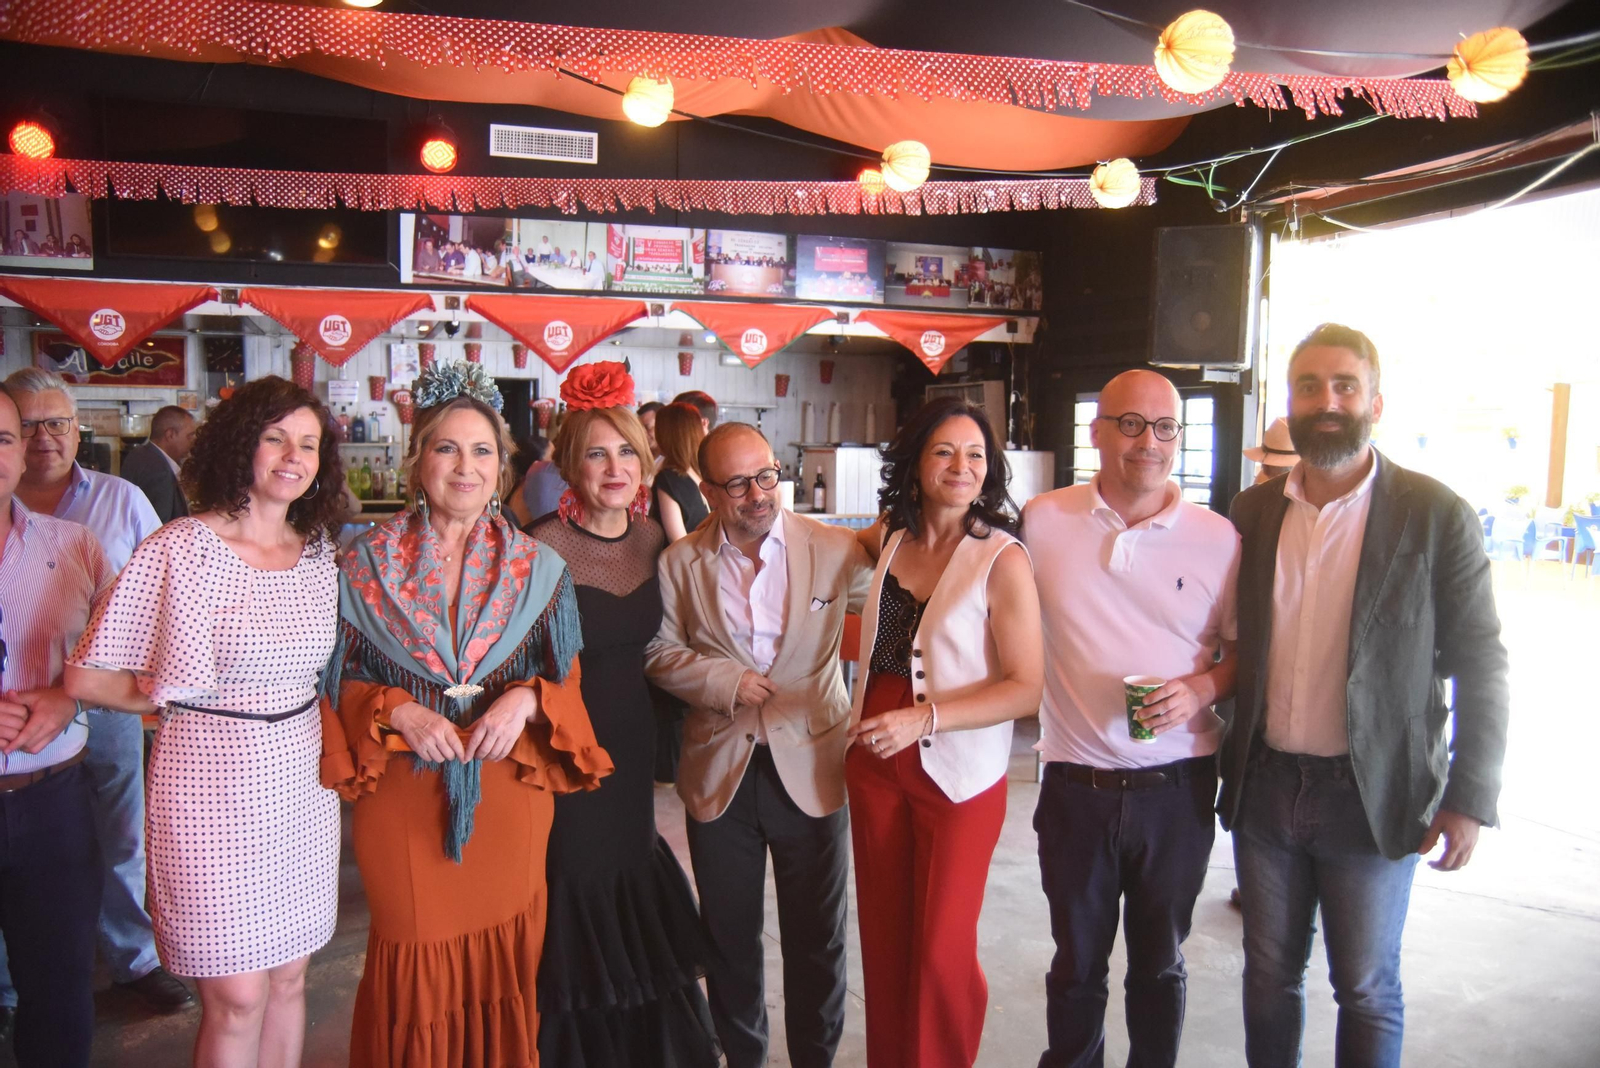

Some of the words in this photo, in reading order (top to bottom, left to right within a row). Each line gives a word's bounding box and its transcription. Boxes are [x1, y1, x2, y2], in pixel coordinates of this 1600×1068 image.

[93, 314, 121, 327] UGT
[324, 319, 347, 332] UGT
[547, 326, 568, 338] UGT
[744, 333, 764, 346] UGT
[923, 334, 943, 345] UGT
[58, 347, 88, 373] Al
[99, 351, 154, 371] aile
